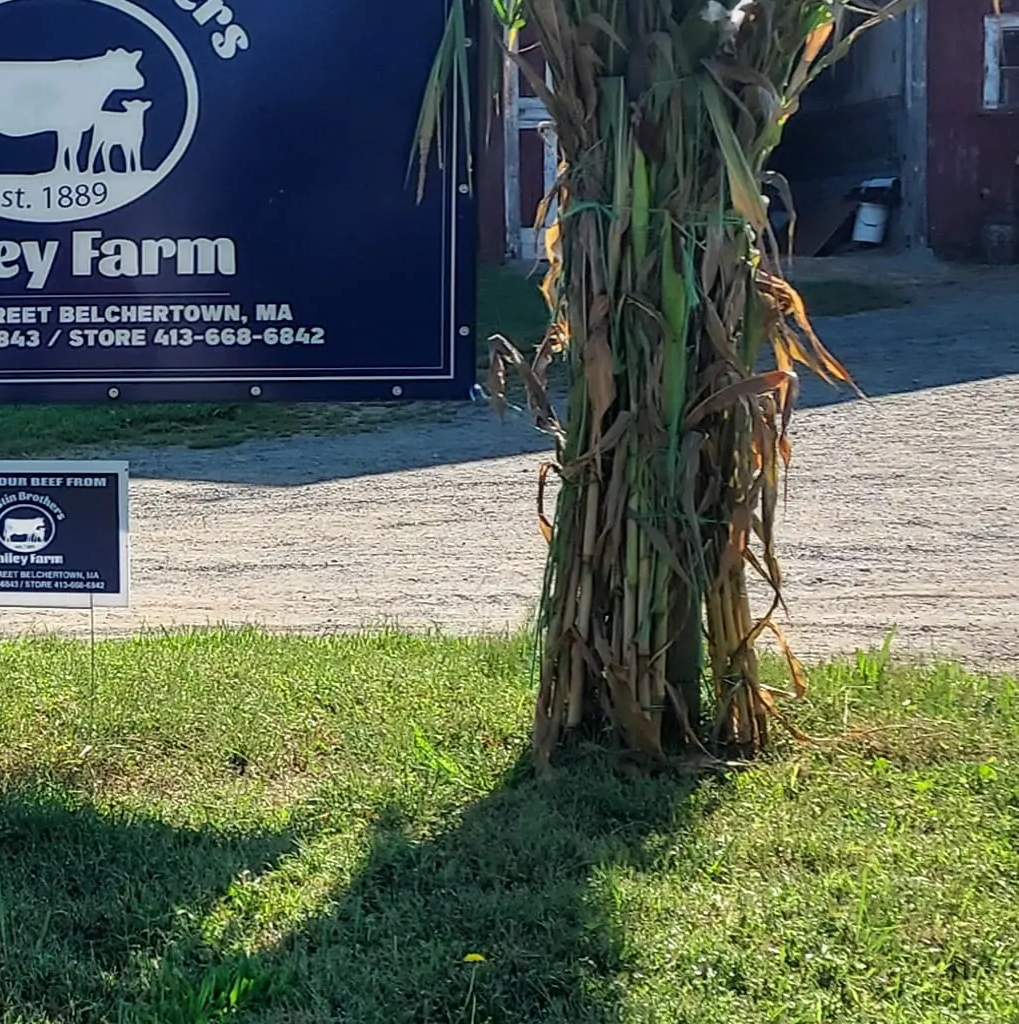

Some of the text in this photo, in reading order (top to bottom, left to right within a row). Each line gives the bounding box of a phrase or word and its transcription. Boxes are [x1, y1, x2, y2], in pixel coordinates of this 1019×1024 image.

[42, 182, 108, 209] 1889
[71, 230, 236, 277] Farm
[59, 304, 248, 324] BELCHERTOWN,
[255, 303, 293, 321] MA
[47, 329, 62, 347] /
[69, 329, 147, 347] STORE
[153, 327, 325, 346] 413-668-6842
[30, 477, 63, 487] BEEF
[66, 477, 107, 487] FROM
[18, 491, 65, 521] Brothers
[30, 553, 64, 564] Farm
[25, 580, 53, 589] STORE
